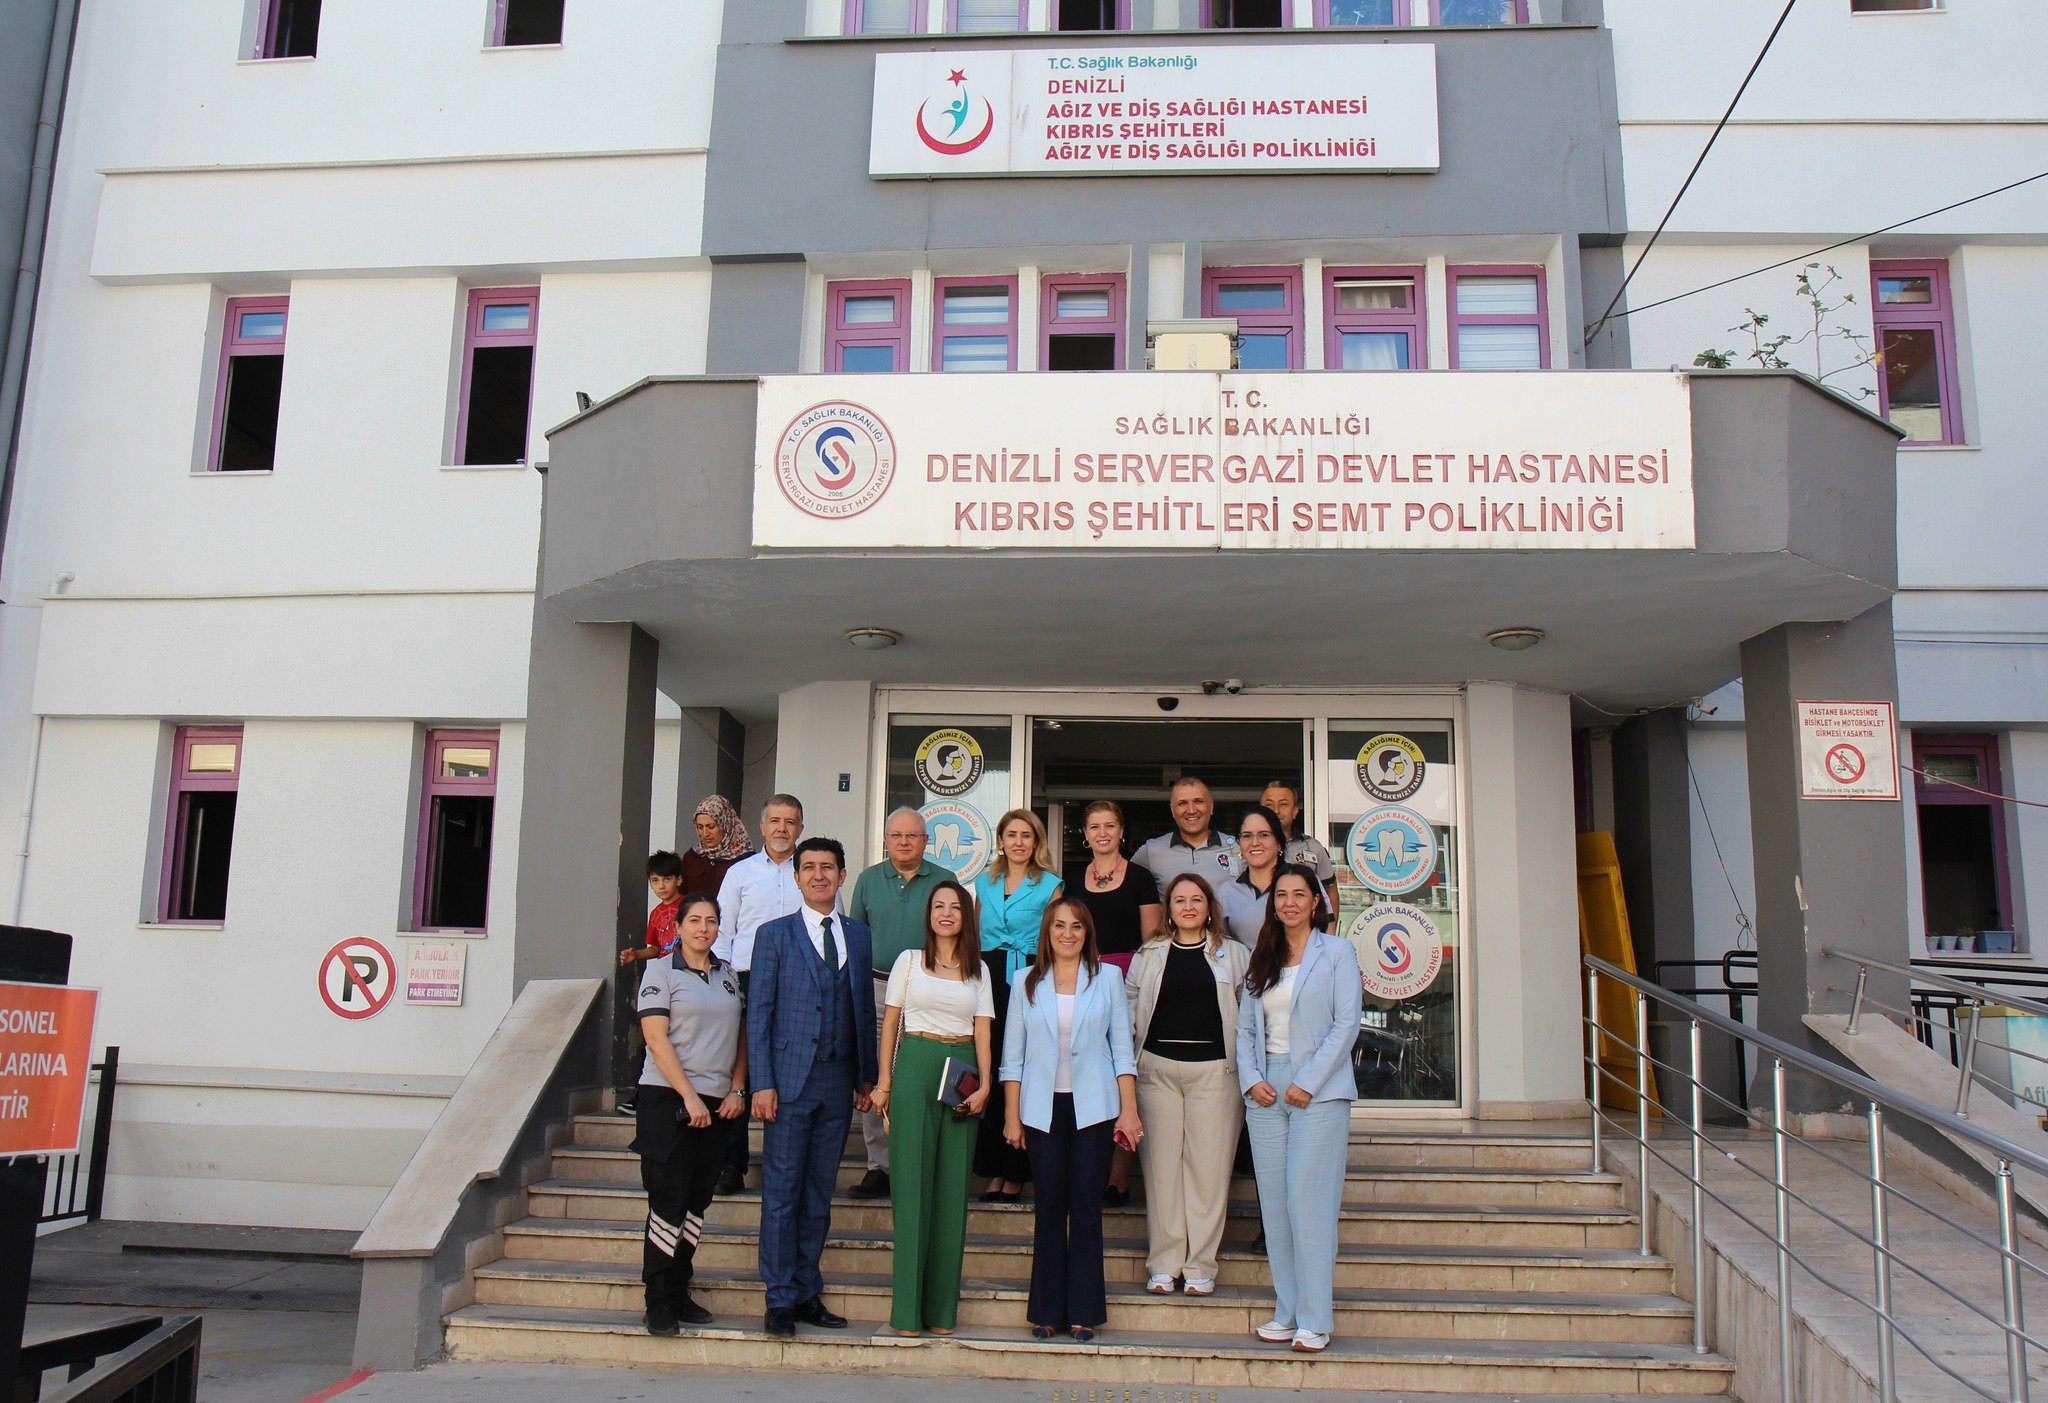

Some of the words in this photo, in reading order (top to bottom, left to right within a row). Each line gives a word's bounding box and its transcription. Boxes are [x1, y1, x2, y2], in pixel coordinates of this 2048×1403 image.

[1047, 56, 1076, 70] T.C.
[1077, 55, 1124, 72] Sağlık
[1128, 54, 1198, 71] Bakanlığı
[1047, 75, 1125, 95] DENİZLİ
[1045, 98, 1092, 119] AĞIZ
[1096, 100, 1123, 118] VE
[1128, 97, 1161, 121] DİŞ
[1166, 97, 1246, 118] SAĞLIĞI
[1252, 95, 1368, 116] HASTANESİ
[1045, 121, 1114, 139] KIBRIS
[1119, 118, 1225, 142] ŞEHİTLERİ
[1045, 140, 1092, 161] AĞIZ
[1096, 142, 1122, 160] VE
[1128, 139, 1161, 163] DİŞ
[1166, 138, 1247, 159] SAĞLIĞI
[1252, 137, 1377, 158] POLİKLİNİĞİ
[801, 408, 837, 428] SAĞLIK
[839, 408, 884, 443] BAKANLIĞI
[1115, 413, 1214, 436] SAĞLIK
[1224, 412, 1371, 436] BAKANLIĞI
[926, 447, 1061, 483] DENİZLİ
[1317, 453, 1455, 484] DEVLET
[1468, 448, 1669, 484] HASTANESİ
[782, 454, 815, 509] SERVERGAZİ
[815, 502, 854, 514] DEVLET
[855, 458, 890, 508] HASTANESİ
[954, 500, 1075, 532] KIBRIS
[1087, 495, 1279, 539] ŞEHİTLERİ
[1292, 501, 1391, 533] SEMT
[1405, 495, 1624, 533] POLİKLİNİĞİ
[1804, 718, 1832, 727] BİSİKLET
[1842, 718, 1885, 727] MOTORSİKLET
[1809, 708, 1838, 716] HASTANE
[1840, 707, 1878, 717] BAHÇESİNDE
[922, 732, 958, 751] SAĞLIĞINIZ
[1815, 728, 1841, 738] GİRMESİ
[1363, 736, 1400, 755] SAĞLIĞINIZ
[918, 760, 932, 786] LÜTFEN
[930, 781, 969, 794] MASKENİZİ
[967, 756, 980, 783] TAKINIZ
[1359, 764, 1373, 790] LÜTFEN
[1372, 787, 1412, 800] MASKENİZİ
[1410, 762, 1423, 790] TAKINIZ
[924, 806, 949, 818] SAĞLIK
[949, 806, 979, 829] BAKANLIĞI
[1369, 812, 1391, 825] SAĞLIK
[1392, 812, 1424, 835] BAKANLIĞI
[1393, 879, 1411, 888] SAĞLIĞI
[1410, 858, 1430, 882] HASTANESİ
[1364, 906, 1393, 923] SAĞLIK
[1395, 906, 1435, 936] BAKANLIĞI
[342, 955, 379, 1002] P
[410, 968, 430, 980] PARK
[1382, 984, 1412, 996] DEVLET
[1414, 946, 1440, 989] HASTANESİ
[408, 987, 426, 997] PARK
[426, 984, 458, 998] ETMEYİNİZ
